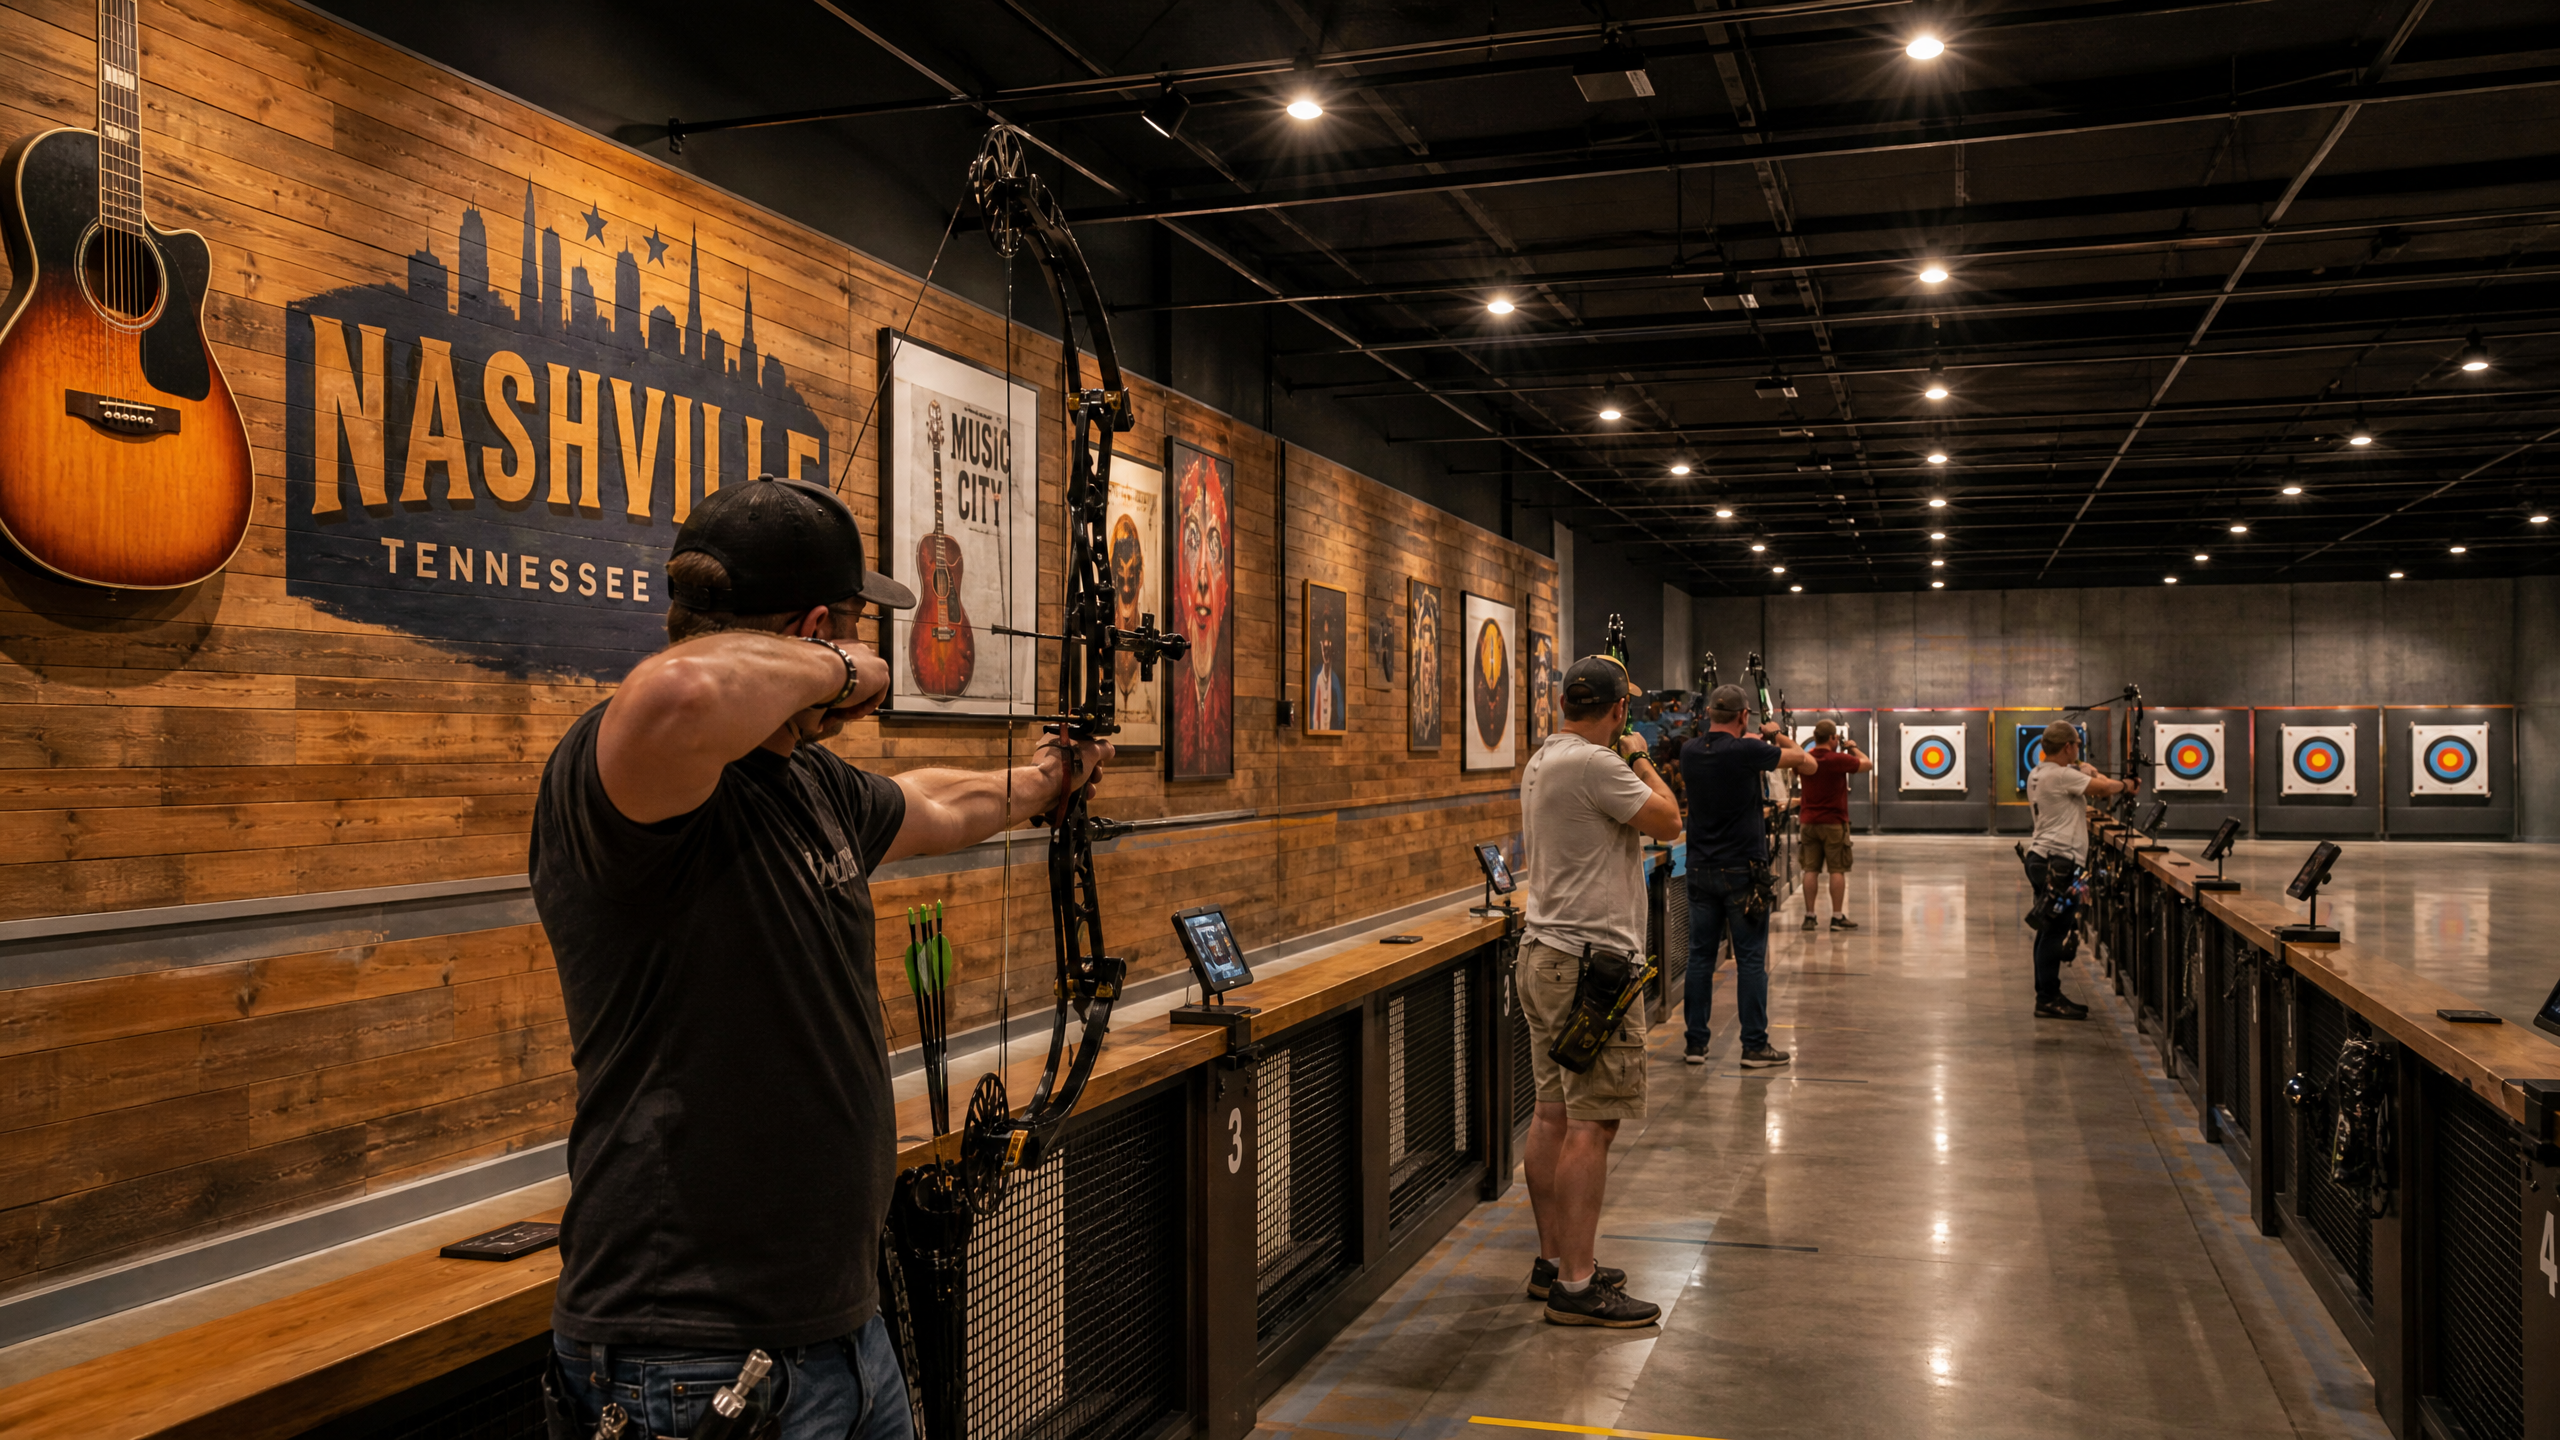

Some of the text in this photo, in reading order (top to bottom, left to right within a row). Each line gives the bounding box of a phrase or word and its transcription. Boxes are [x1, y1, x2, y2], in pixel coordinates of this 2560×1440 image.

[951, 413, 1010, 474] MUSIC
[958, 470, 1002, 527] CITY
[381, 537, 650, 602] TENNESSEE
[1228, 1108, 1243, 1174] 3
[2540, 1210, 2558, 1298] 4
